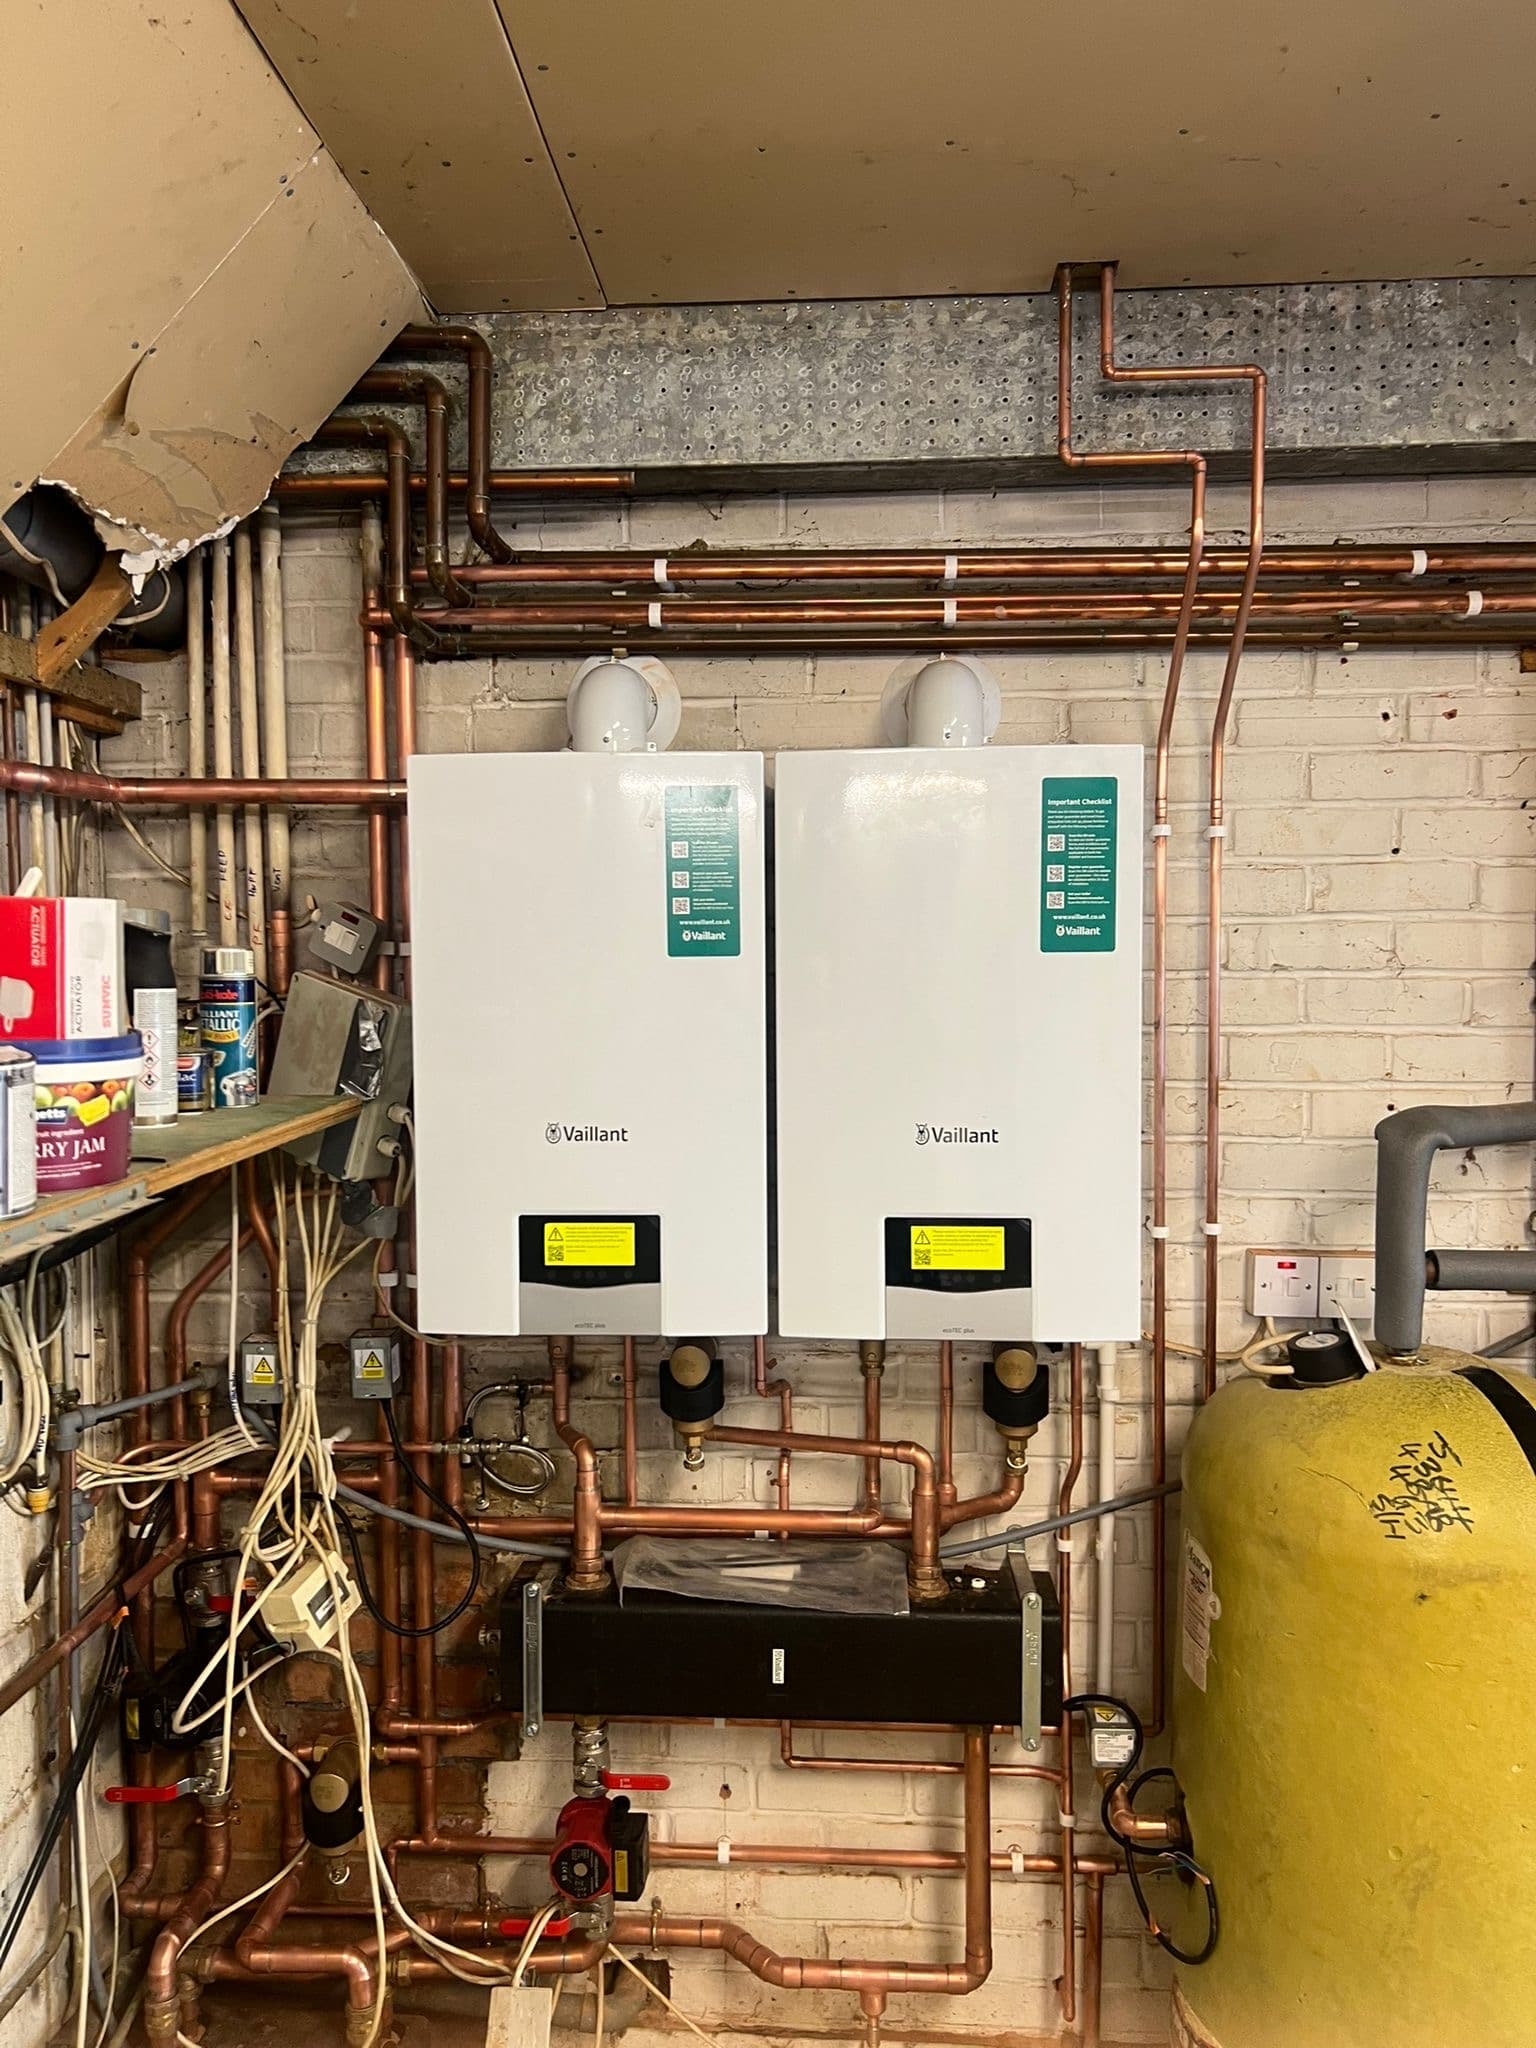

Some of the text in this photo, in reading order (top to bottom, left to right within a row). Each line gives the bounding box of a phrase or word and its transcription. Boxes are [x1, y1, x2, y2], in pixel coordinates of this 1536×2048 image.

[31, 905, 40, 967] ACTUATOR
[692, 930, 727, 940] Vaillant
[1066, 926, 1101, 936] Vaillant
[563, 1126, 629, 1142] Vaillant
[932, 1127, 999, 1143] Vaillant
[72, 1136, 106, 1160] JAM
